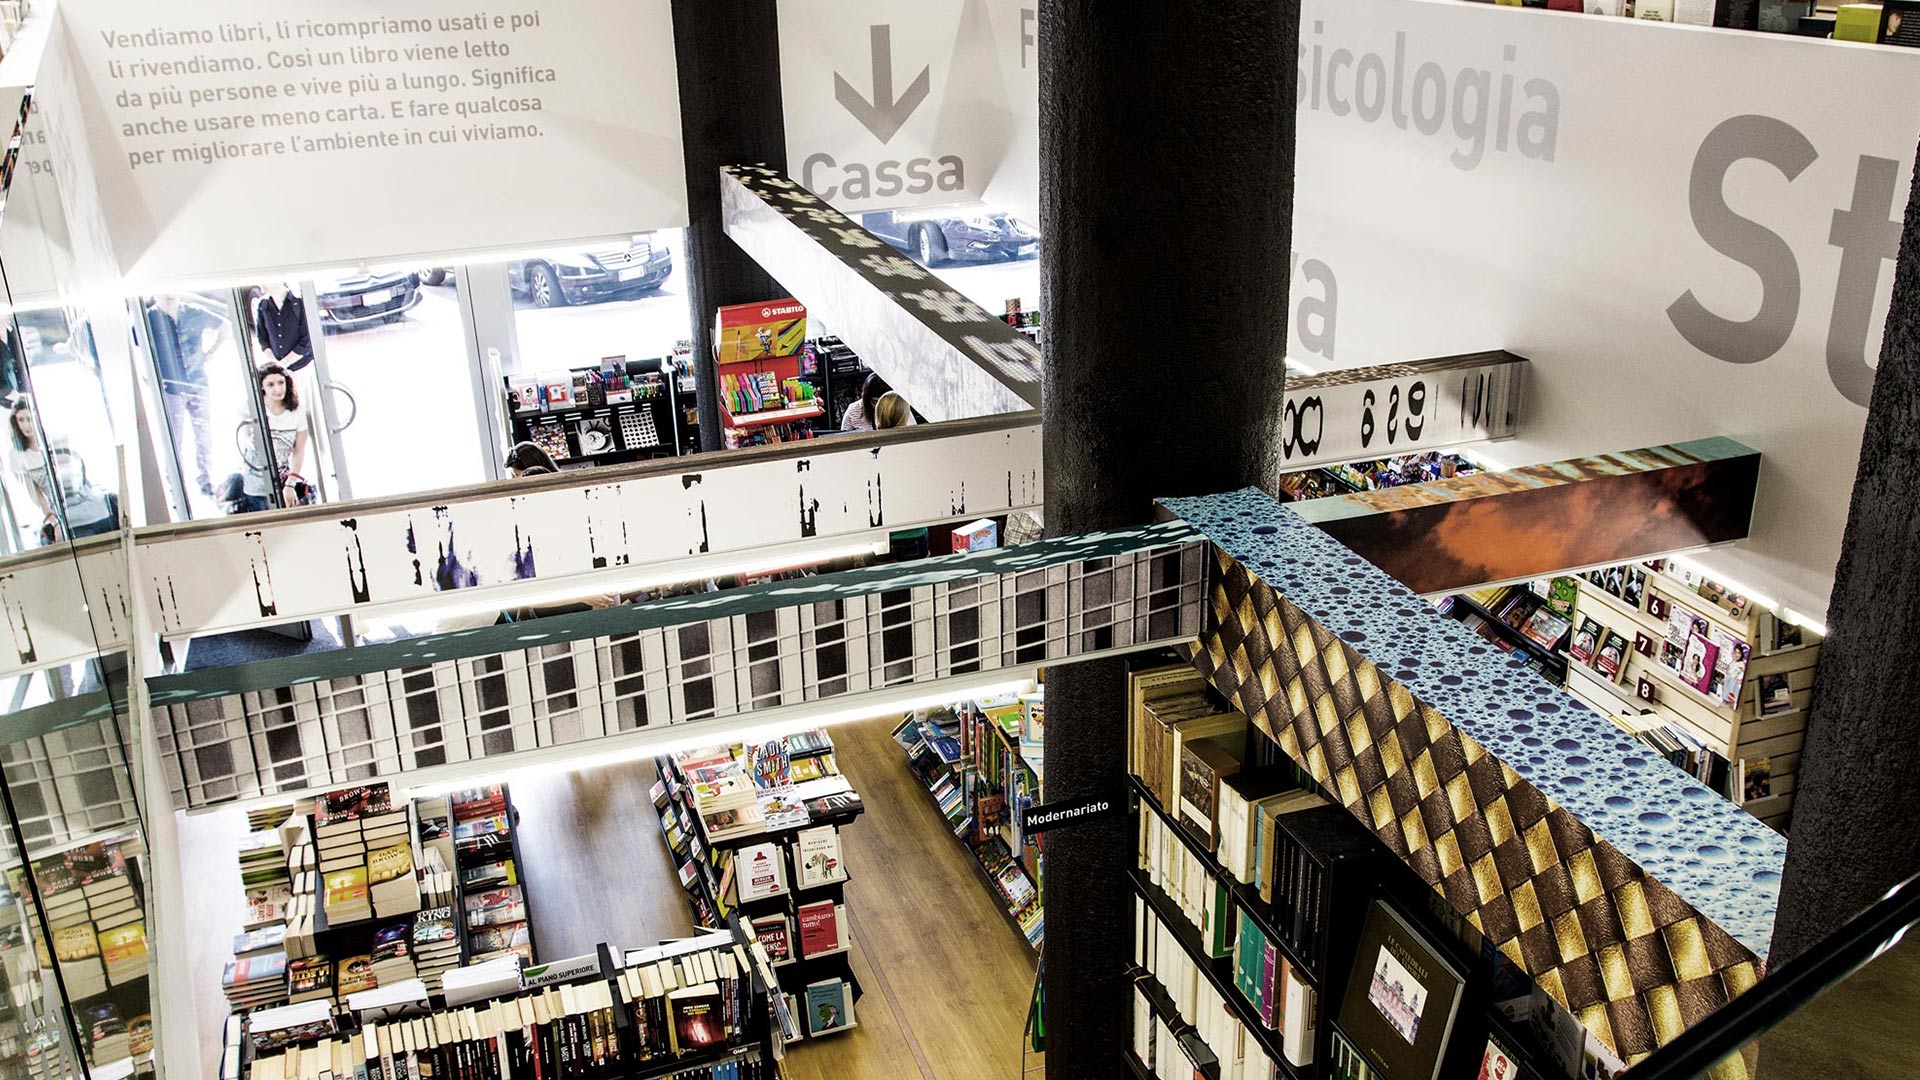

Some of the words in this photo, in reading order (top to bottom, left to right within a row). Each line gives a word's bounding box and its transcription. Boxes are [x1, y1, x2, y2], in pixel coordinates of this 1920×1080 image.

[101, 27, 214, 49] Vendiamo
[219, 21, 271, 43] libri,
[276, 20, 290, 40] li
[296, 16, 432, 40] ricompriamo
[438, 12, 487, 32] usati
[494, 15, 505, 29] e
[511, 10, 540, 32] poi
[108, 59, 124, 79] li
[130, 55, 262, 78] rivendiamo.
[267, 48, 313, 70] Così
[319, 50, 345, 67] un
[350, 44, 399, 65] libro
[404, 43, 459, 62] viene
[464, 40, 510, 58] letto
[116, 89, 143, 109] da
[149, 84, 182, 110] più
[189, 84, 278, 108] persone
[283, 82, 296, 97] e
[300, 77, 342, 96] vive
[348, 72, 379, 97] più
[385, 76, 397, 91] a
[402, 72, 466, 92] lungo.
[471, 66, 556, 90] Significa
[122, 116, 188, 137] anche
[195, 114, 255, 132] usare
[262, 108, 320, 127] meno
[325, 102, 385, 122] carta.
[390, 101, 404, 119] E
[409, 99, 449, 118] fare
[455, 96, 542, 119] qualcosa
[128, 150, 165, 170] per
[173, 141, 285, 164] migliorare
[291, 129, 399, 153] l'ambiente
[405, 128, 423, 146] in
[429, 126, 458, 144] cui
[462, 123, 544, 142] viviamo.
[802, 152, 965, 201] Cassa
[772, 305, 804, 316] STABILO
[1651, 600, 1659, 615] 6
[1639, 636, 1648, 652] 7
[1641, 683, 1650, 698] 8
[755, 741, 787, 761] ZADIE
[757, 755, 789, 776] SMITH
[1027, 800, 1109, 827] Modernariato
[418, 911, 451, 923] KING
[802, 913, 834, 923] cambiamo
[758, 932, 775, 943] COME
[775, 931, 784, 940] LA
[528, 978, 537, 986] AL
[538, 973, 557, 983] PIANO
[558, 964, 594, 979] SUPERIORE
